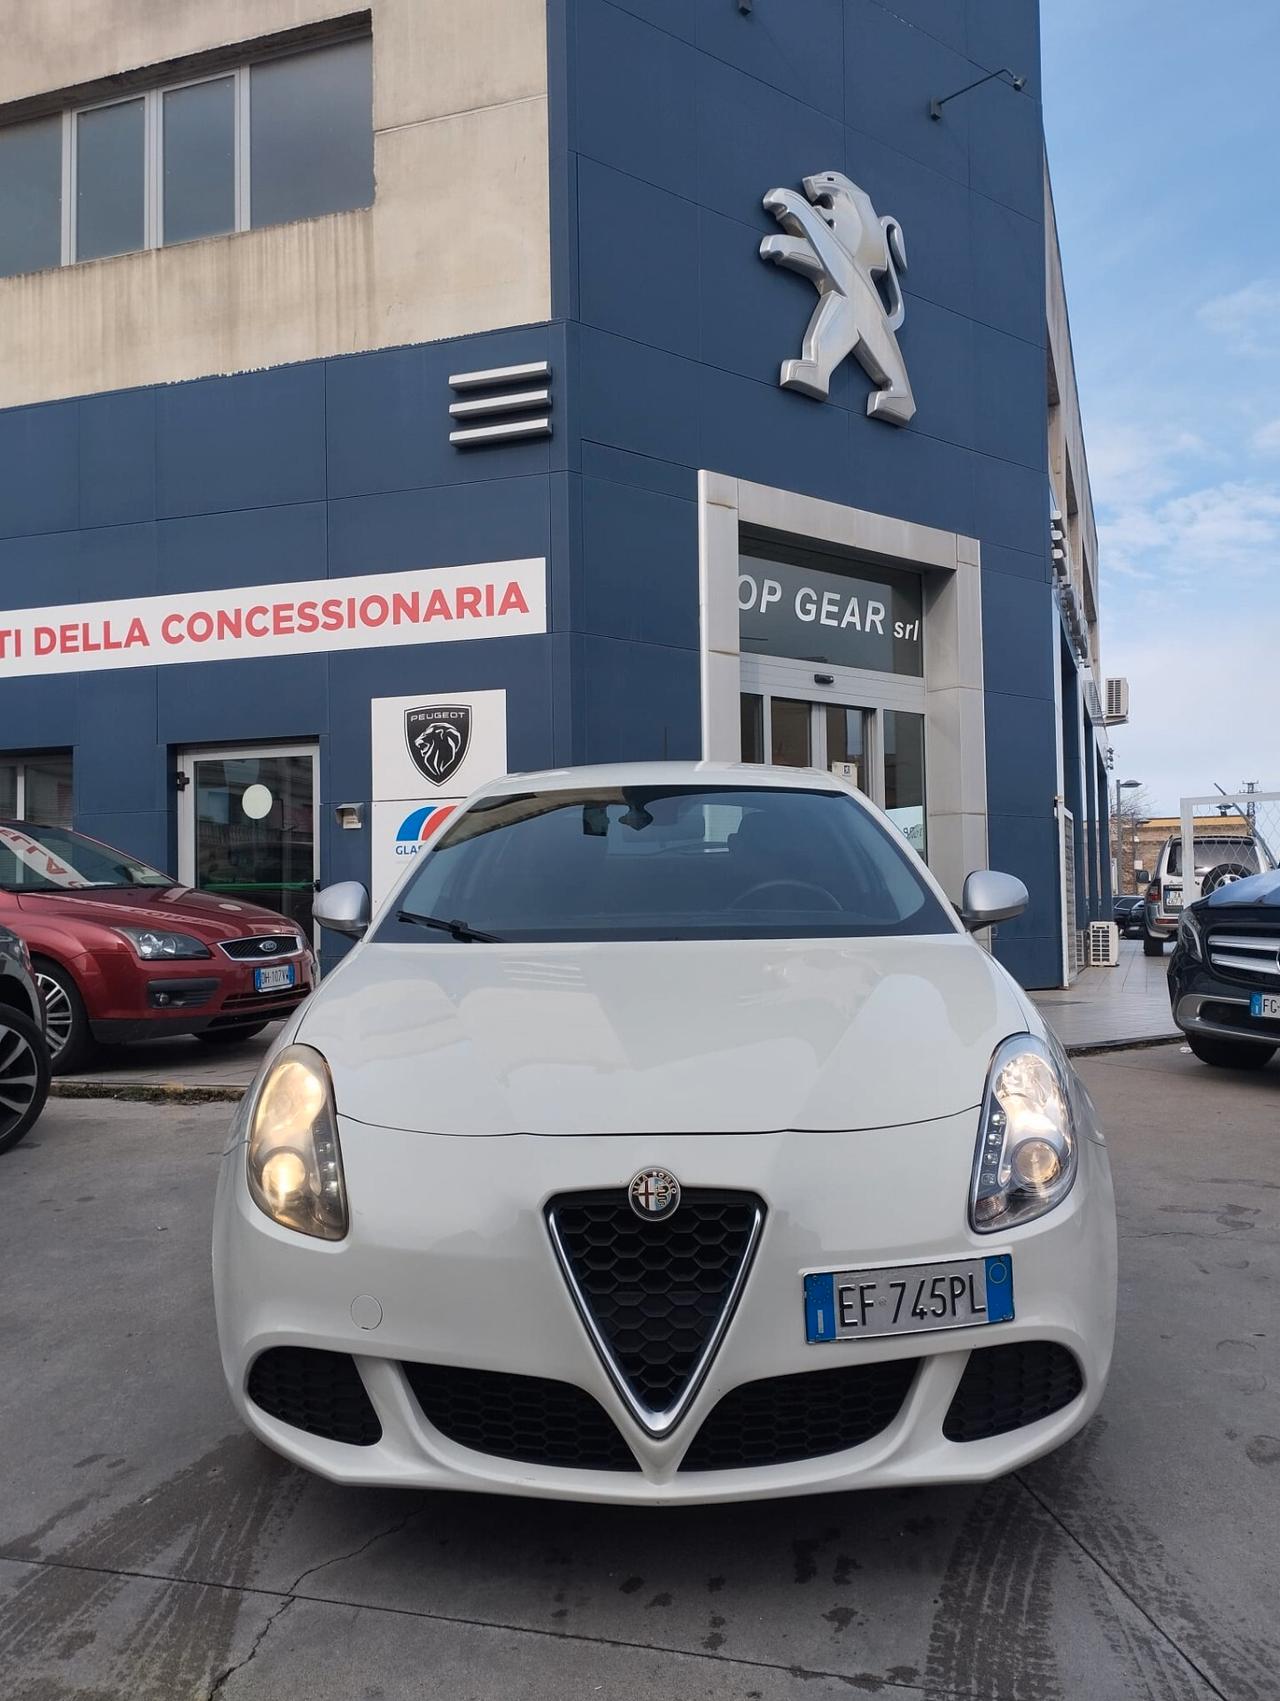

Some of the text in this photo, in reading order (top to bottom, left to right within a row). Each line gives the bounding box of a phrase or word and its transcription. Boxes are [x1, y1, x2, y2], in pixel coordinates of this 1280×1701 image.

[34, 617, 150, 656] DELLA
[160, 581, 530, 644] CONCESSIONARIA
[794, 587, 886, 635] GEAR
[893, 619, 919, 642] srl
[410, 711, 466, 722] PEUGEOT
[632, 1171, 677, 1196] ALFA ROMEO
[838, 1282, 877, 1328] EF
[889, 1272, 987, 1324] 745PL
